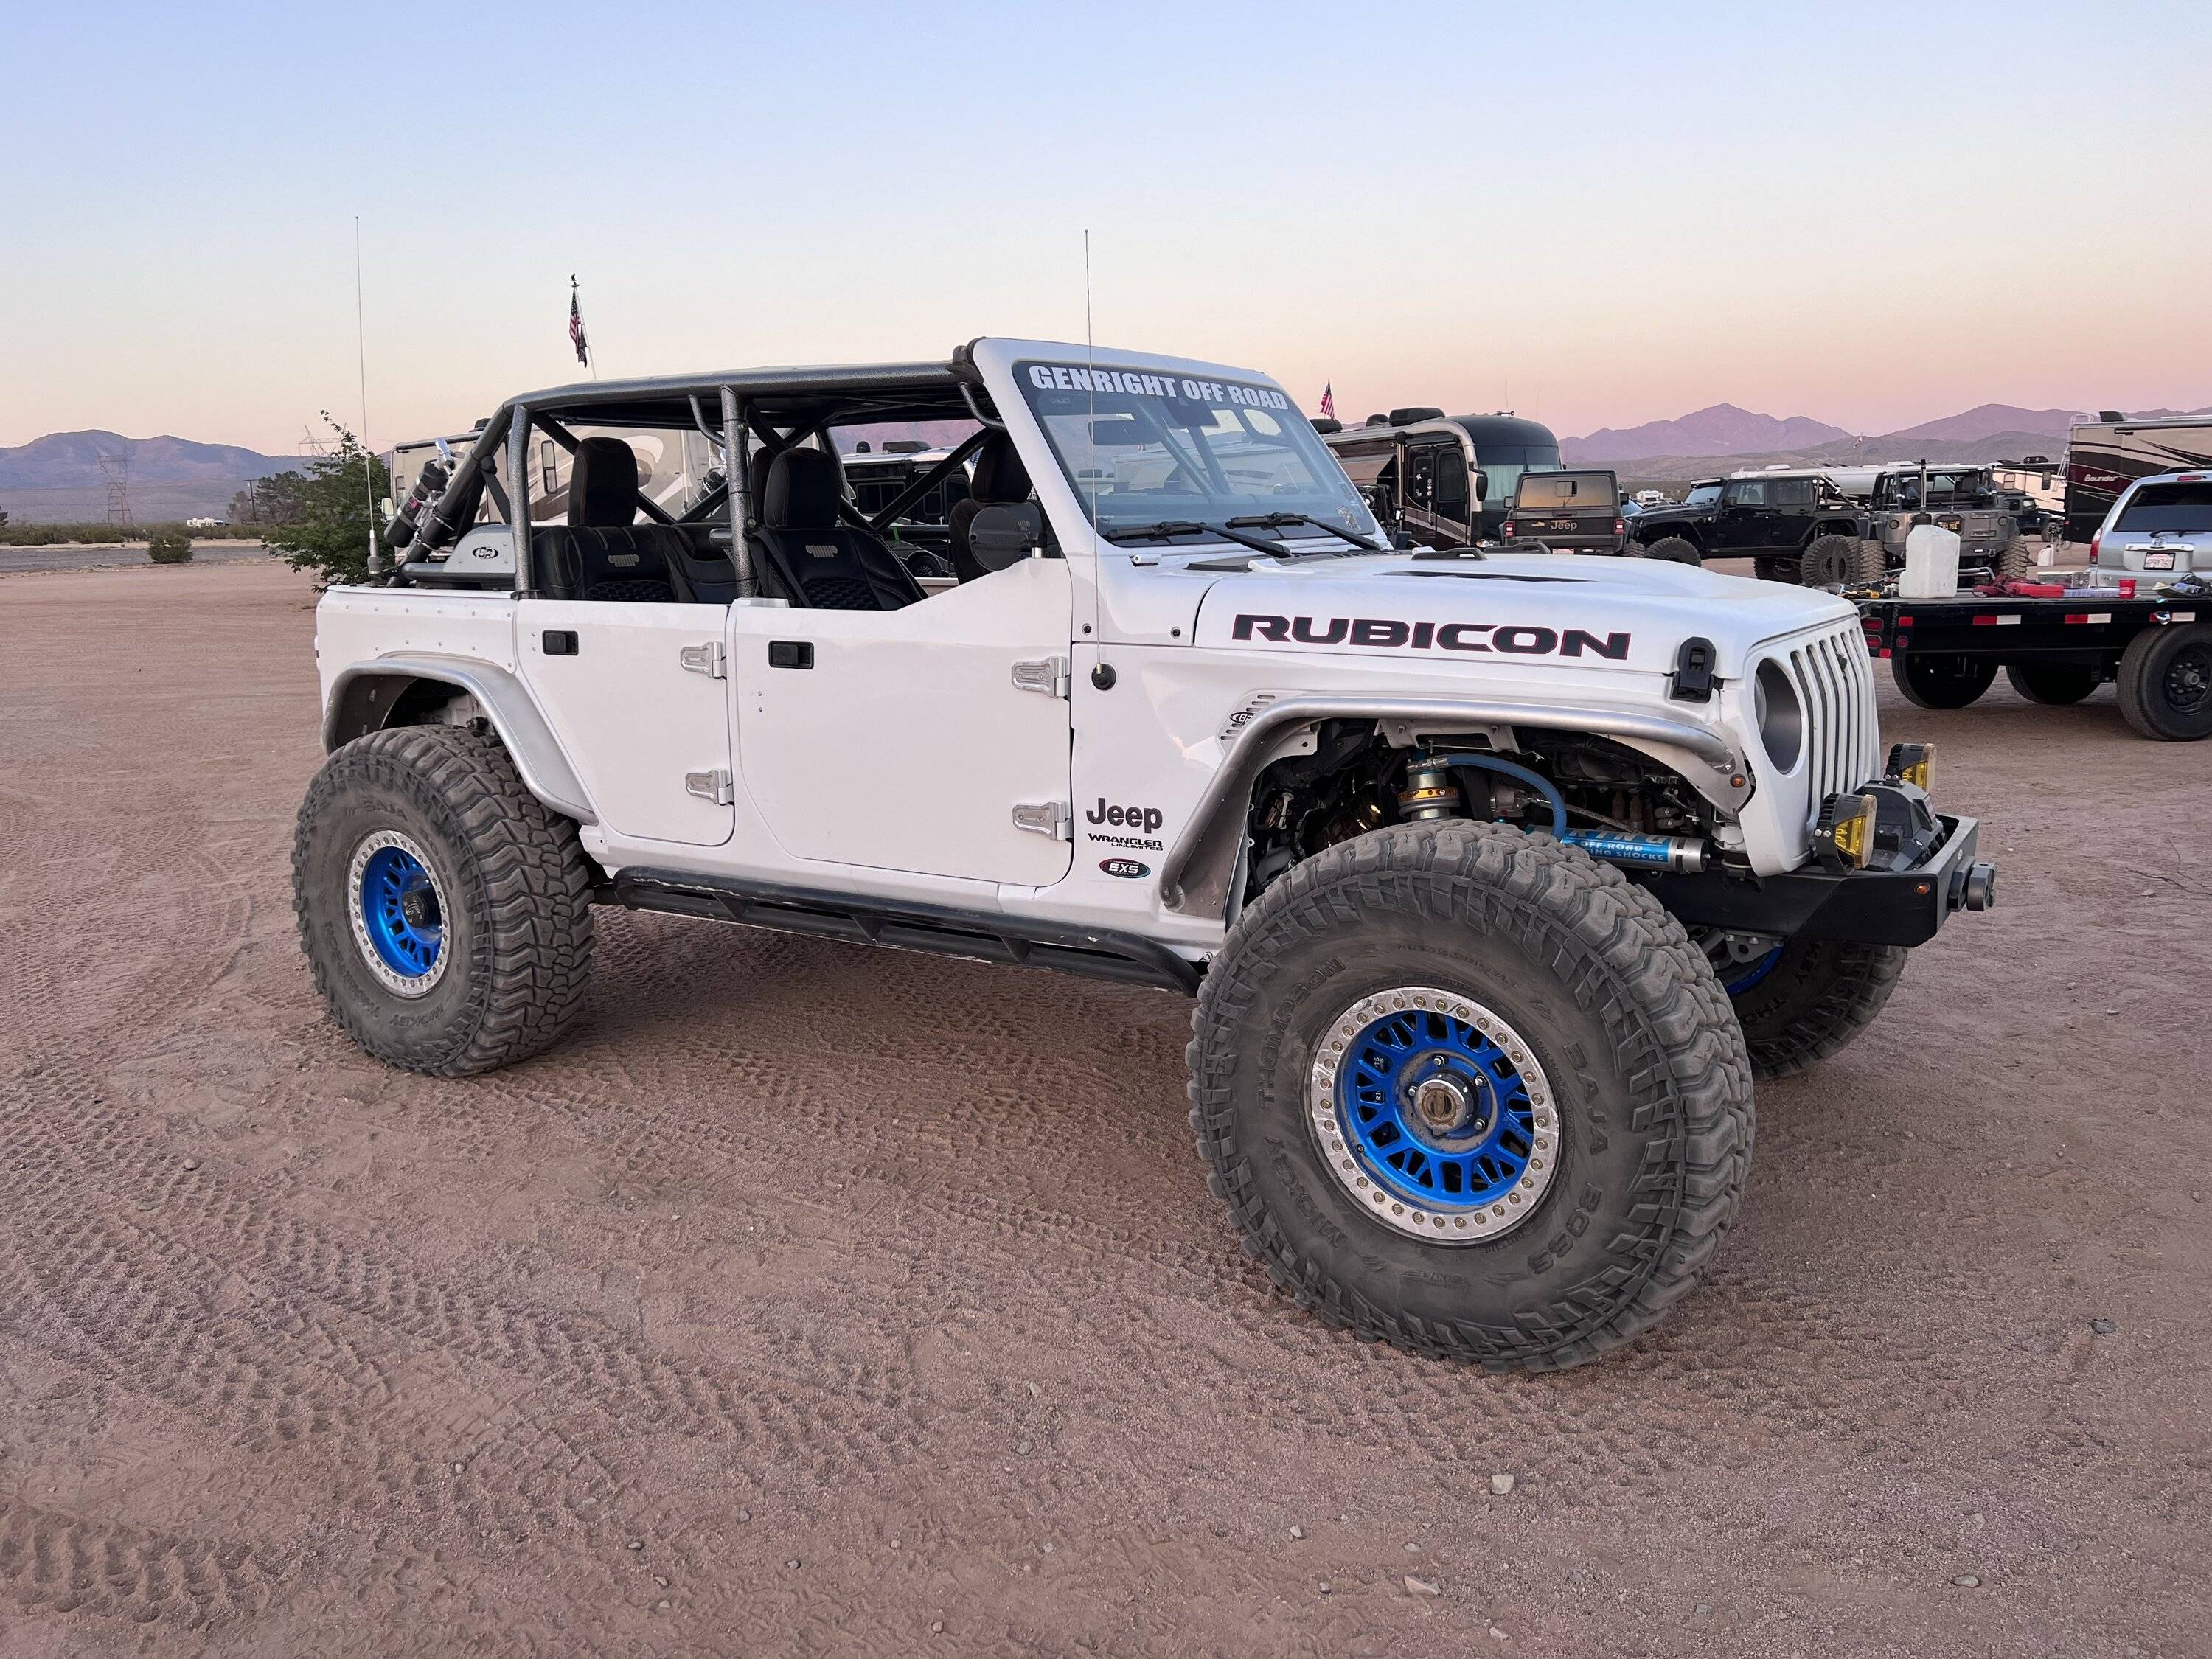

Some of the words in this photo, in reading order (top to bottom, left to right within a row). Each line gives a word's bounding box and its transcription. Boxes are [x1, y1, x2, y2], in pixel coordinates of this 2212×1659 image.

[1029, 366, 1178, 397] GENRIGHT
[1180, 378, 1225, 403] OFF
[1228, 384, 1289, 411] ROAD
[2084, 473, 2118, 482] Bounder
[1551, 520, 1578, 531] Jeep
[1232, 613, 1631, 661] RUBICON
[1086, 797, 1163, 834] Jeep
[1088, 833, 1163, 847] WRANGLER
[1111, 842, 1164, 851] UNLIMITED
[1615, 850, 1664, 861] SHOCKS
[1109, 863, 1139, 874] EXS
[1258, 956, 1346, 1108] THOMPSON
[1563, 1042, 1609, 1156] BAJA
[1527, 1182, 1604, 1275] BOSS
